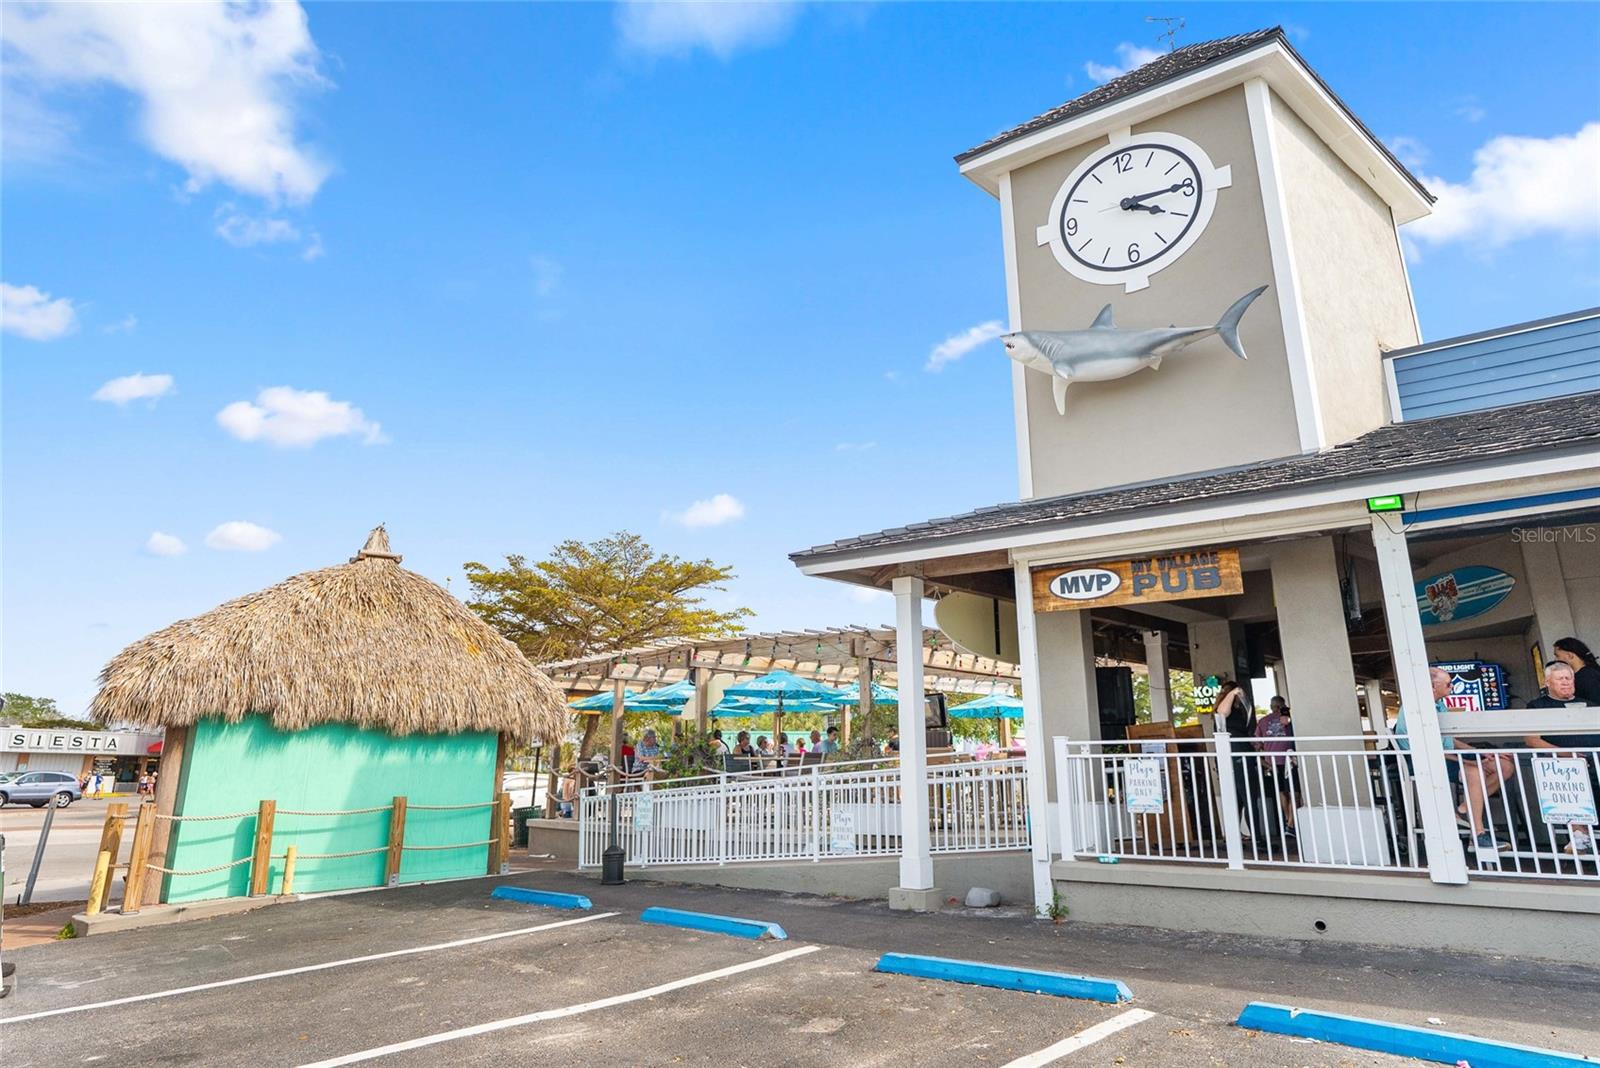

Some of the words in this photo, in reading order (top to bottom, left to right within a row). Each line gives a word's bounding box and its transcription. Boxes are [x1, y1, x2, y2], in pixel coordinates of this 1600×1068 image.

[1113, 153, 1133, 174] 12
[1182, 177, 1195, 197] 3
[1066, 217, 1078, 236] 9
[1127, 243, 1140, 263] 6
[1131, 559, 1152, 574] MY
[1060, 573, 1112, 594] MVP
[1133, 567, 1222, 597] PUB
[1454, 663, 1476, 671] LIGHT
[1445, 696, 1479, 712] NFL
[13, 734, 117, 749] SIESTA
[1129, 762, 1154, 778] Plaza
[1541, 761, 1579, 781] Plaza
[1129, 779, 1158, 787] PARKING
[1542, 780, 1586, 792] PARKING
[1135, 788, 1153, 797] ONLY
[1552, 792, 1579, 803] ONLY
